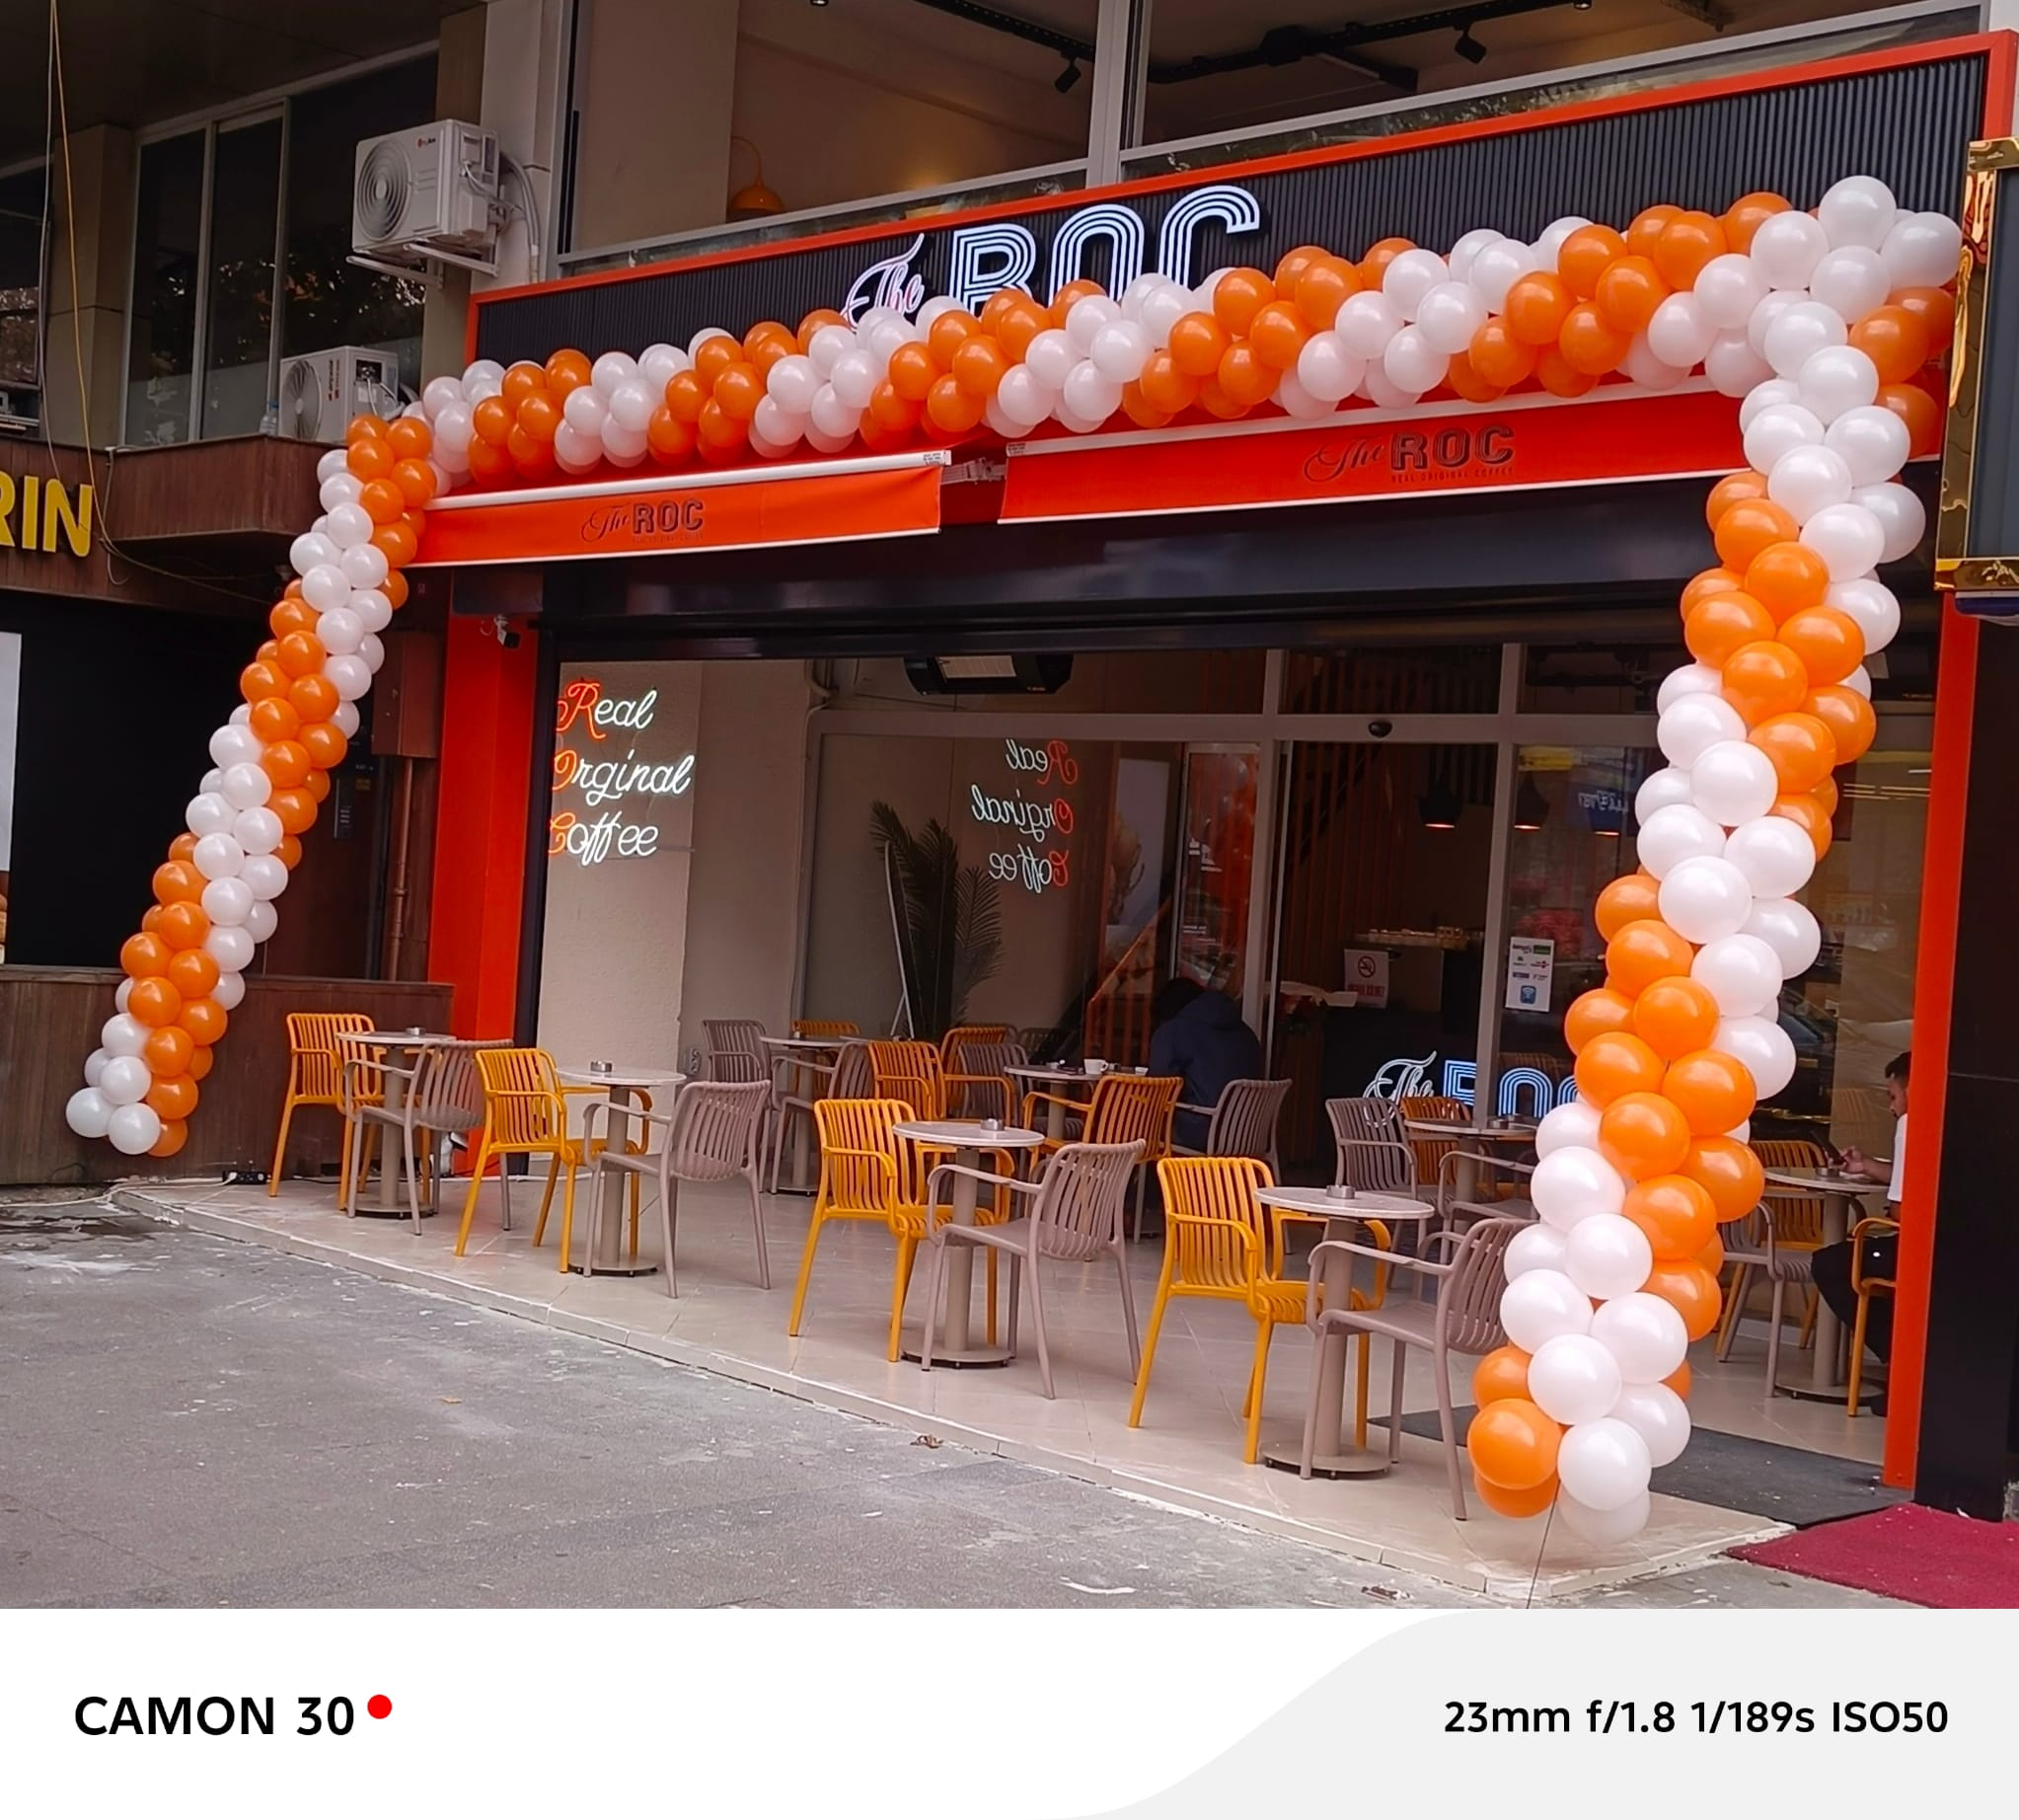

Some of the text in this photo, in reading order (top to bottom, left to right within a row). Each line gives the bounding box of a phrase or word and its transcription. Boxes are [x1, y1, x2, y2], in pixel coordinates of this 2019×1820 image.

[841, 186, 1260, 333] The ROC
[1304, 423, 1515, 482] The ROC
[581, 498, 704, 541] The ROC
[556, 682, 658, 739] Real
[552, 749, 695, 806] Orginal
[548, 811, 659, 866] Coffee
